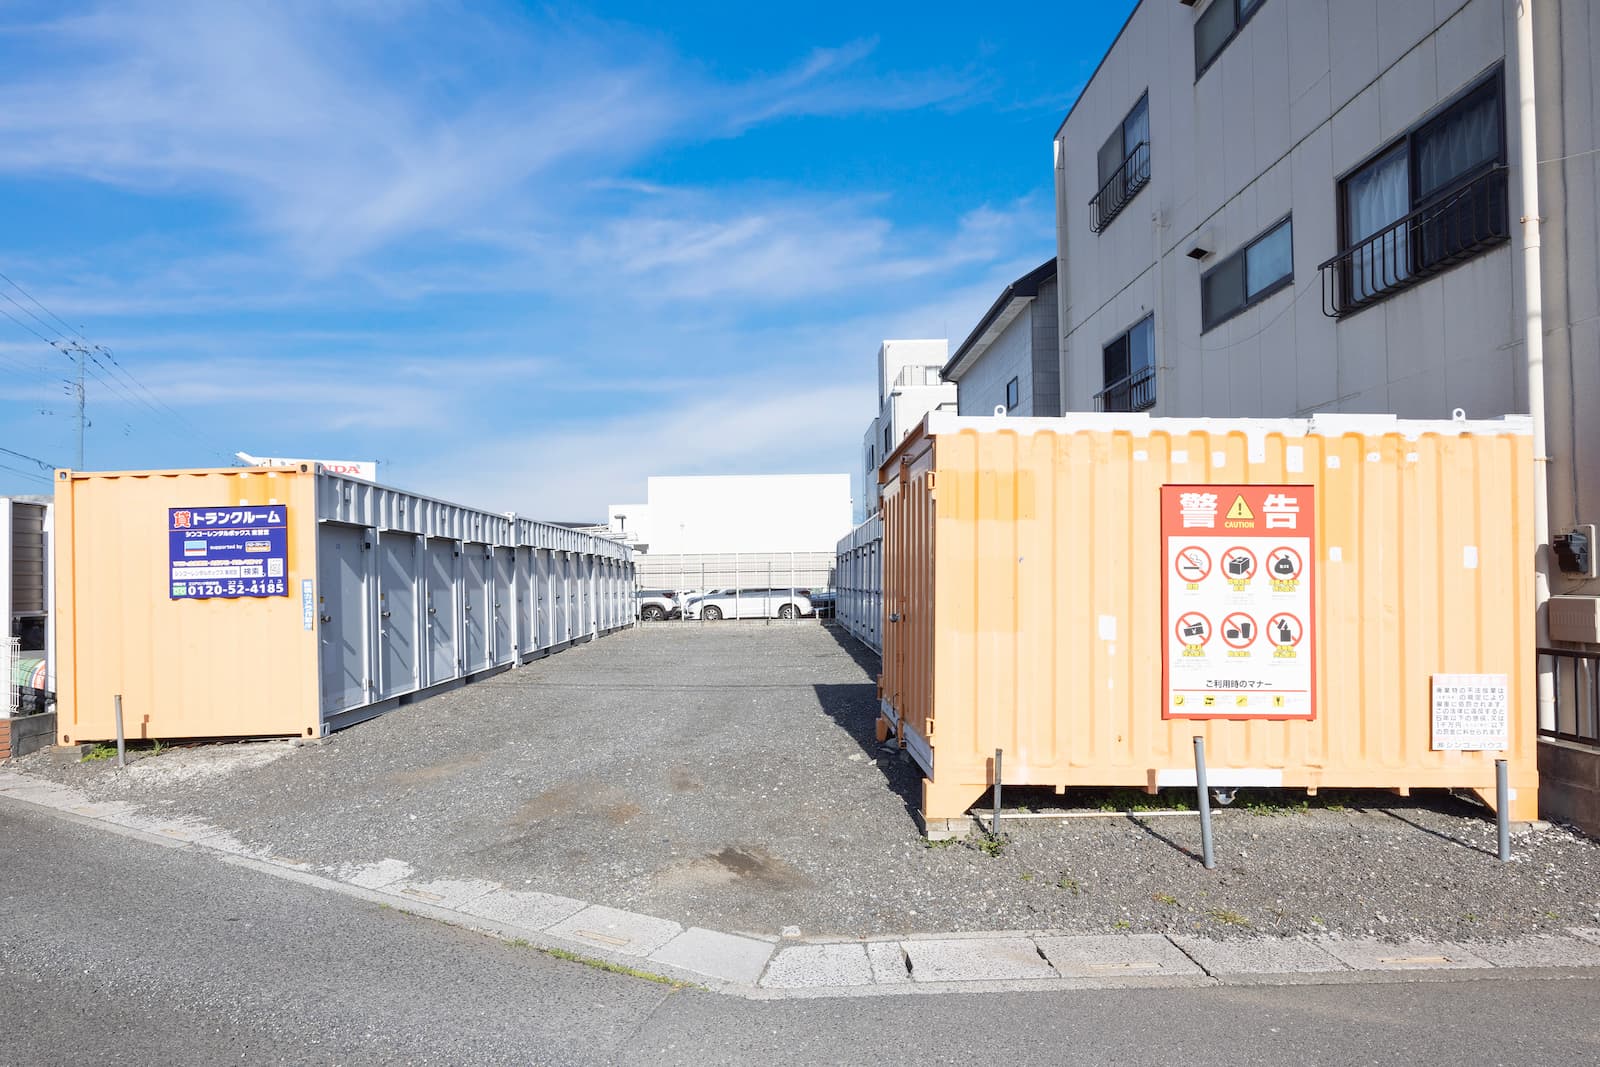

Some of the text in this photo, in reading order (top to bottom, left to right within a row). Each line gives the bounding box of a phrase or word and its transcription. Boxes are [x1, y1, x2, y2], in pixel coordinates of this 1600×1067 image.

[1180, 493, 1300, 529] 警 告
[192, 510, 281, 526] トランクルーム
[1224, 521, 1255, 529] CAUTION
[243, 567, 260, 576] 検索
[187, 583, 284, 596] 0120-52-4185
[1206, 679, 1273, 689] ご利用時のマナー
